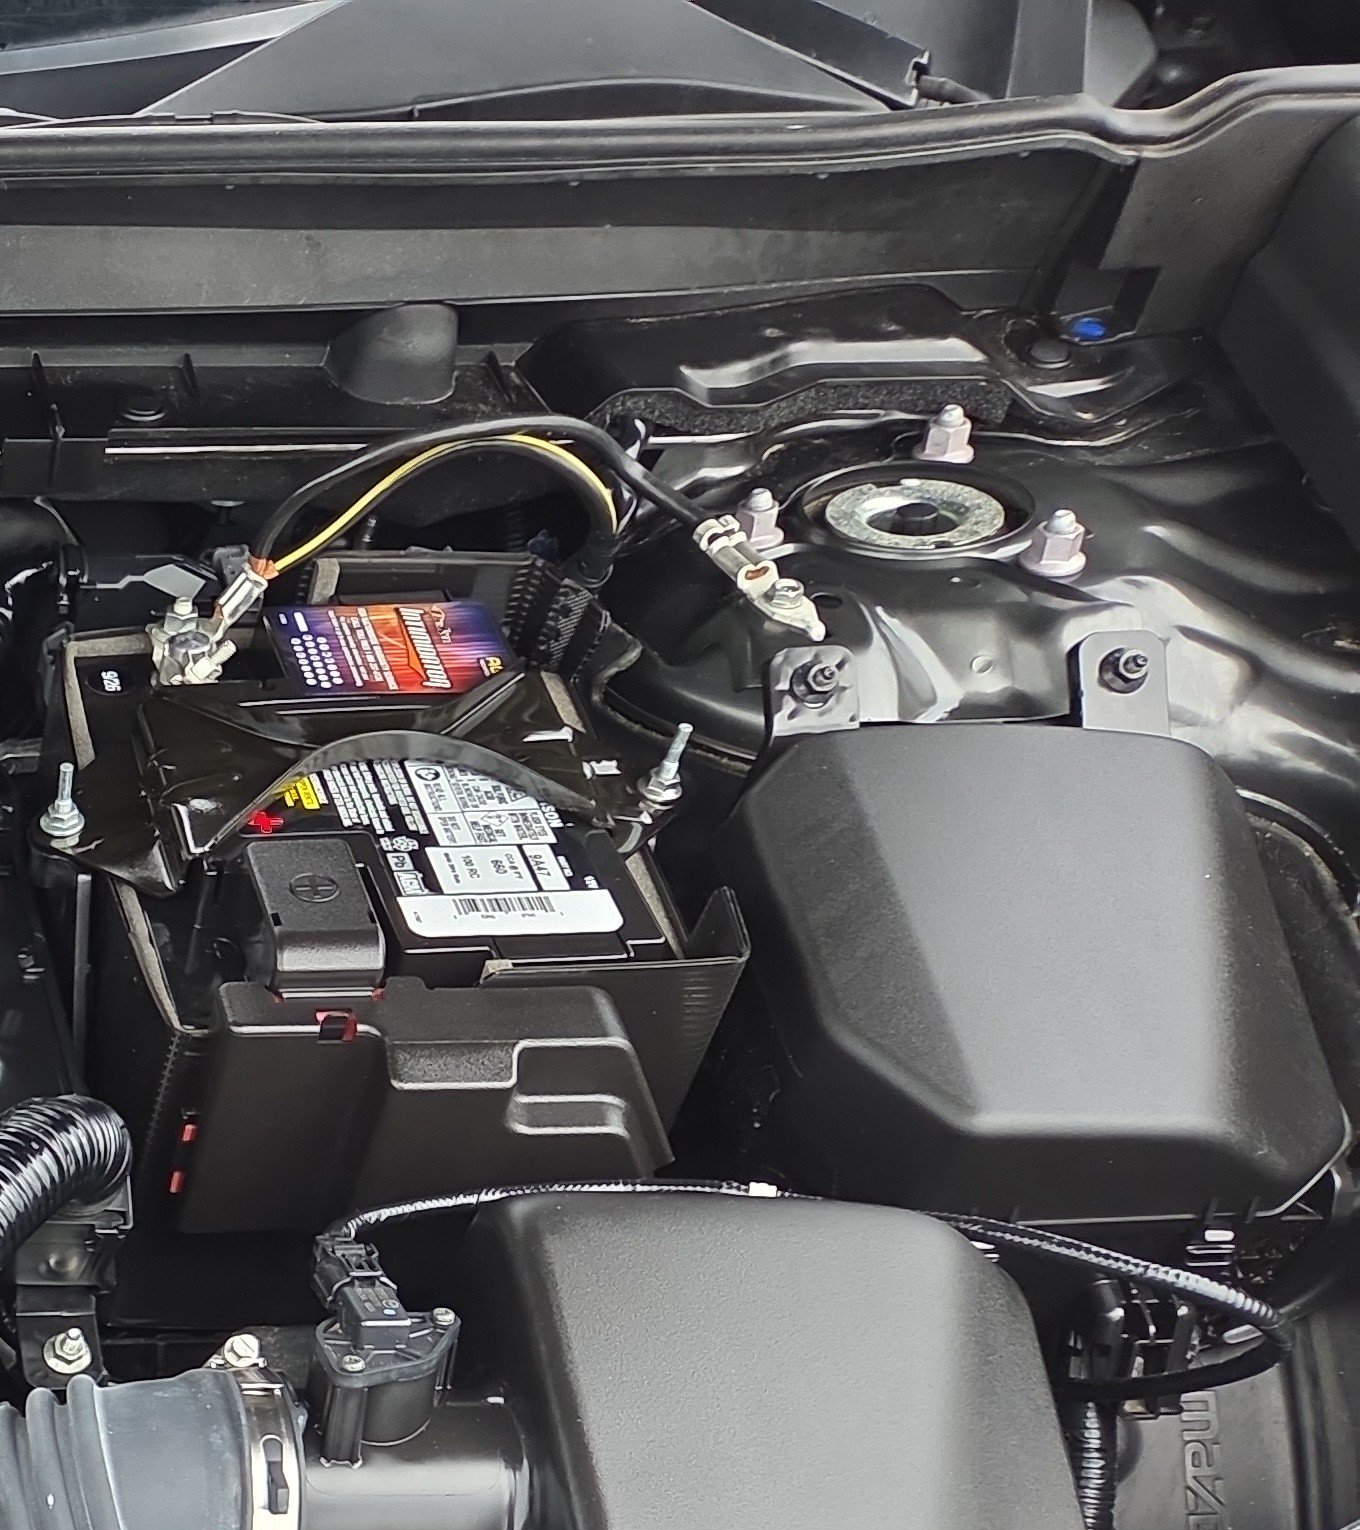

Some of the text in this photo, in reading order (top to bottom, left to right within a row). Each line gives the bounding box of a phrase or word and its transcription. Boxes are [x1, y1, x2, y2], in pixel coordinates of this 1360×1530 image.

[391, 855, 406, 868] Pb
[461, 855, 481, 879] 100 RC
[528, 854, 552, 877] 9A47
